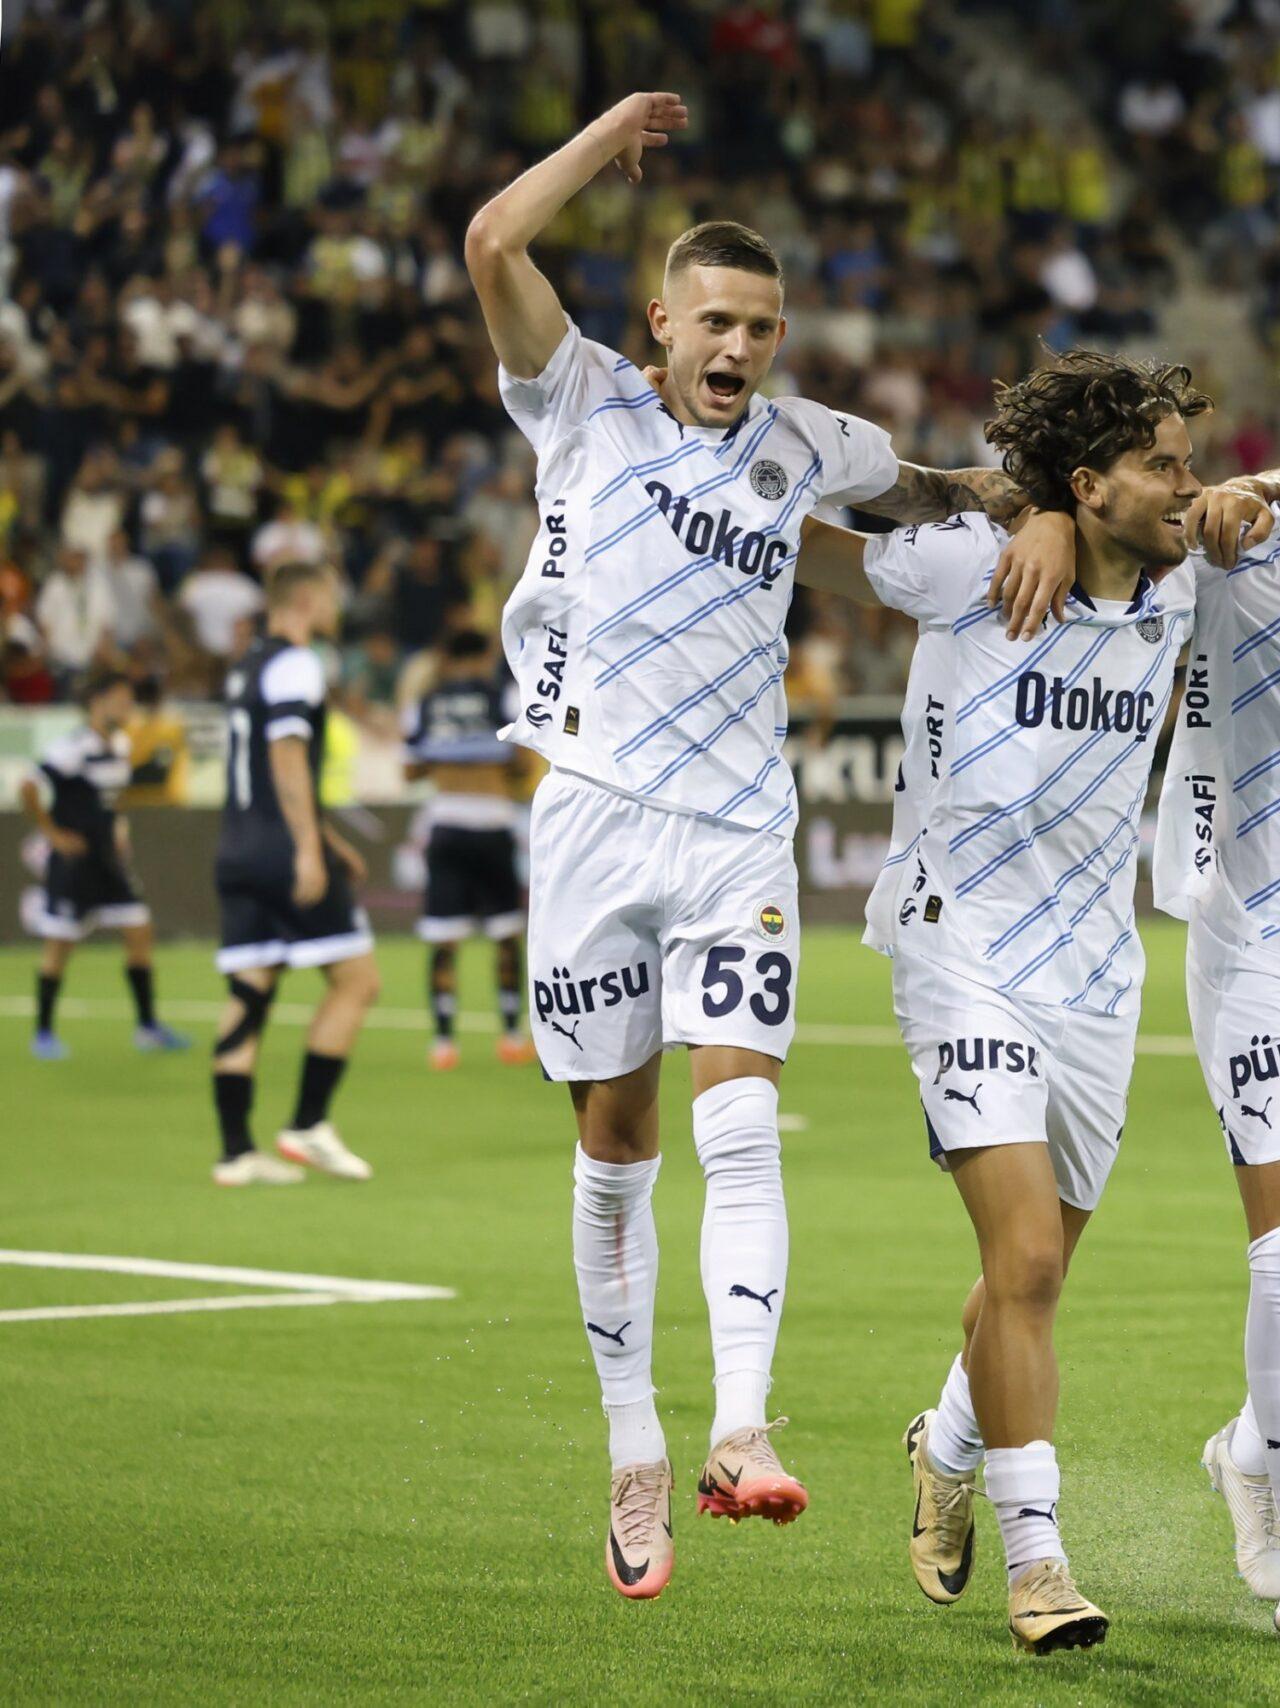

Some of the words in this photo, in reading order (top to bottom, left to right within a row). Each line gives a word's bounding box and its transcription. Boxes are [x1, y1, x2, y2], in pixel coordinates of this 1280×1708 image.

[1015, 671, 1154, 742] Otokoç
[534, 960, 650, 1023] pürsu
[701, 946, 792, 1026] 53
